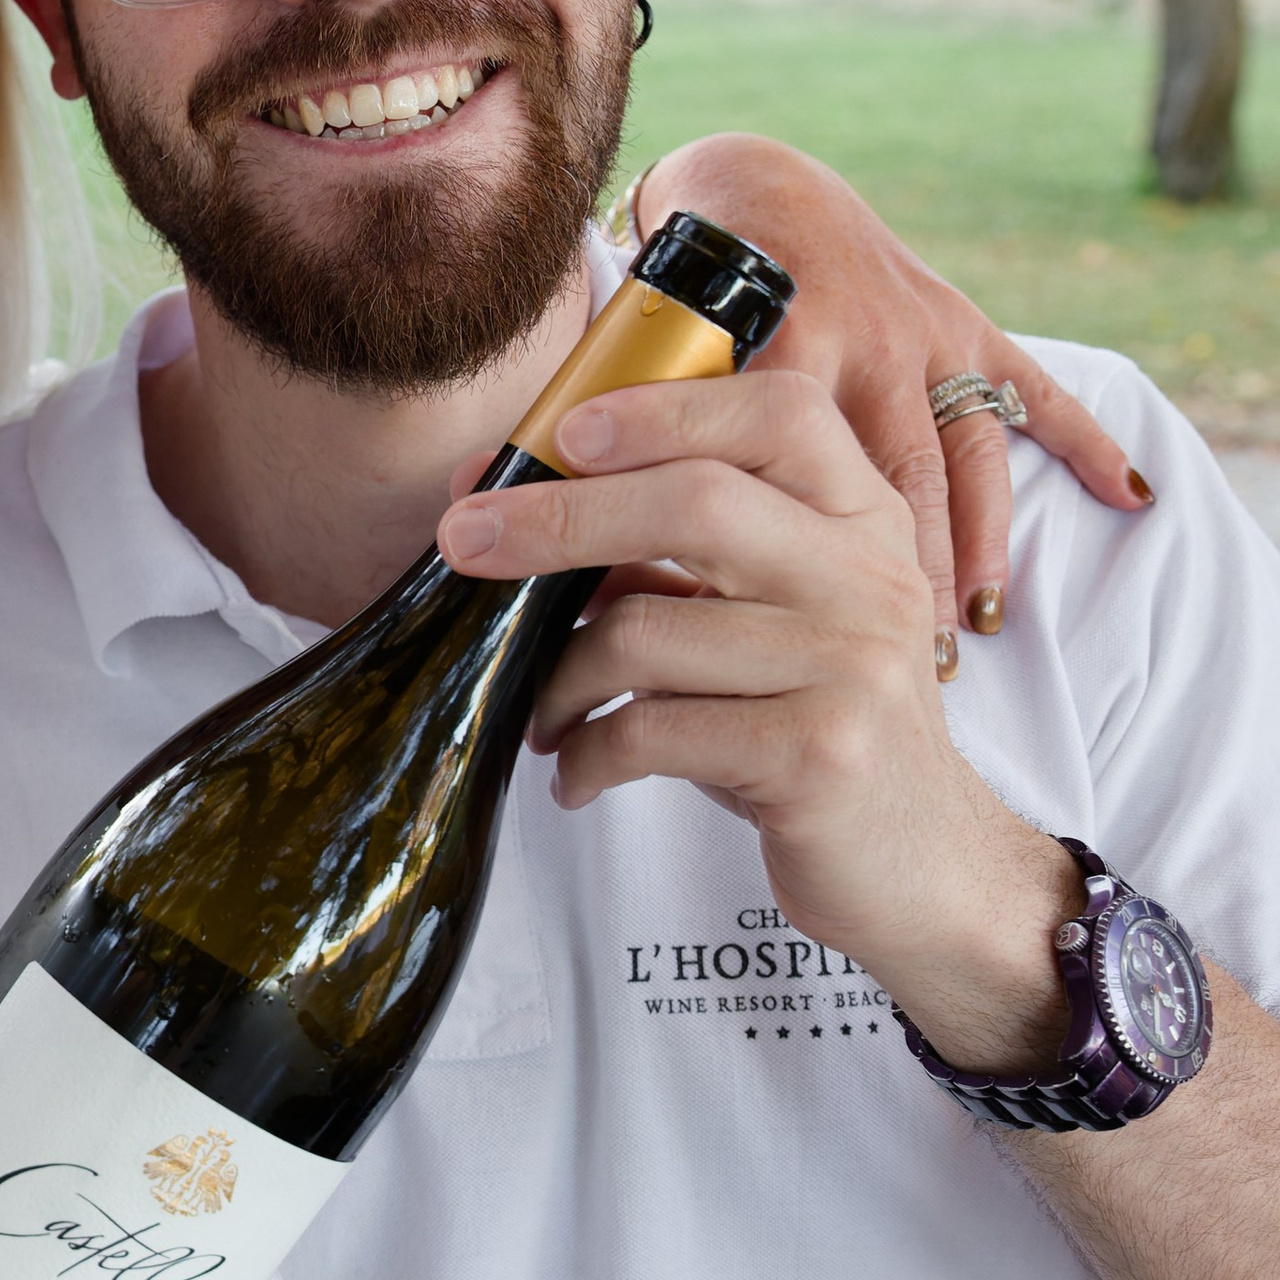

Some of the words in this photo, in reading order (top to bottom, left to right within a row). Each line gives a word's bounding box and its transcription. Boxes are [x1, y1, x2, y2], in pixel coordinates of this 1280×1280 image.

[737, 908, 790, 930] CH
[627, 941, 867, 983] L'HOSPI
[645, 997, 708, 1015] WINE
[718, 994, 814, 1013] RESORT
[834, 989, 888, 1008] BEAC
